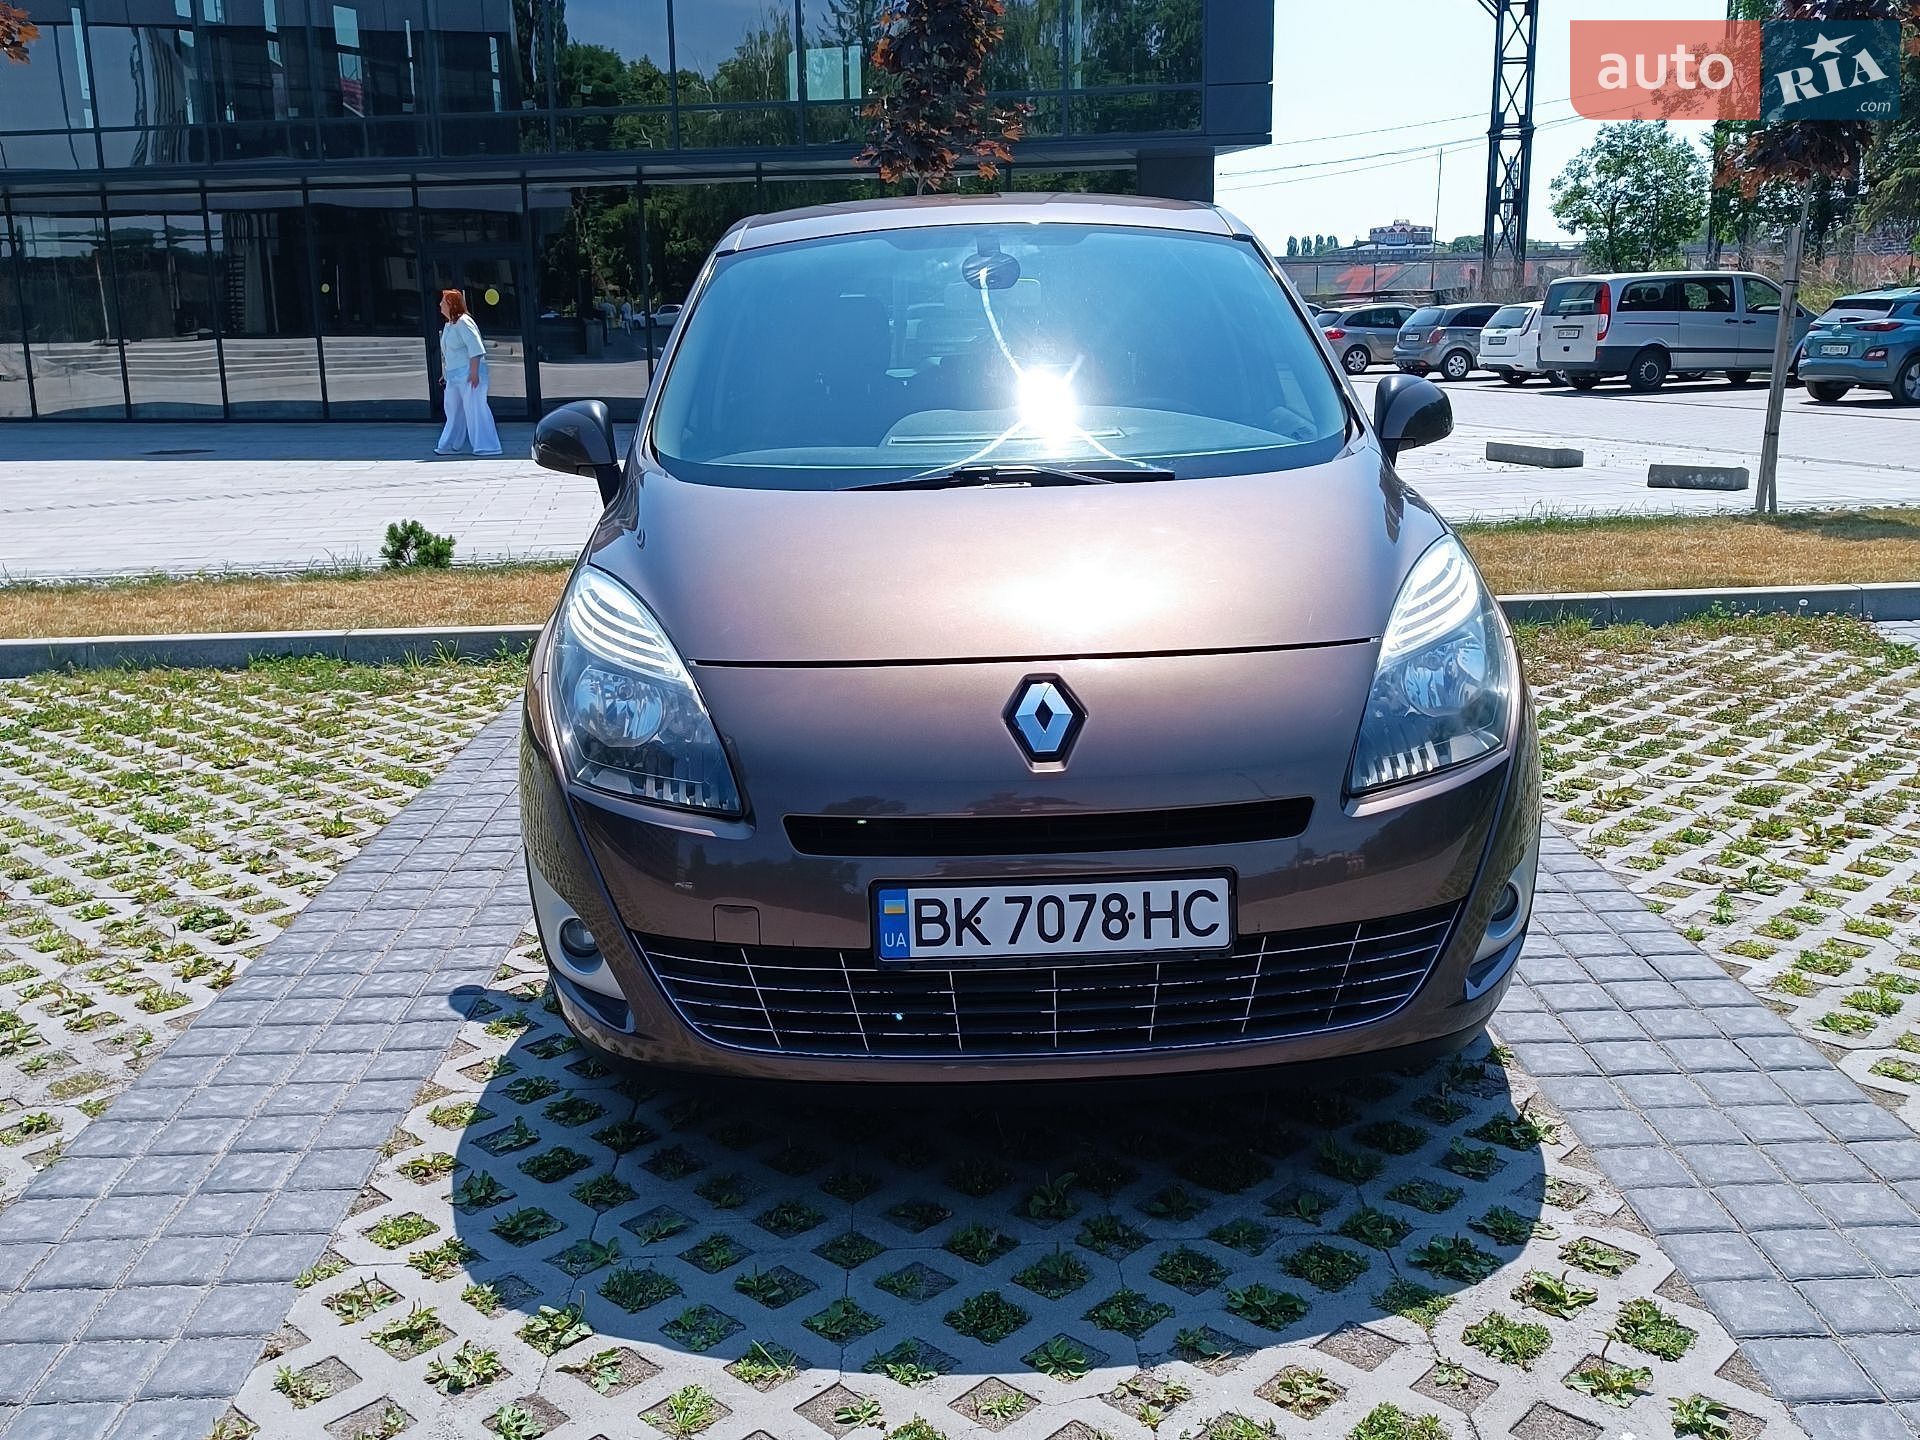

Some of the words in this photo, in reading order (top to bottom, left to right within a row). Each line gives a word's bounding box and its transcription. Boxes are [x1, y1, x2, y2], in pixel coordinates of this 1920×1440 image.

[914, 896, 992, 948] BK
[1003, 892, 1130, 945] 7078
[1142, 888, 1220, 940] HC
[884, 932, 907, 947] UA
